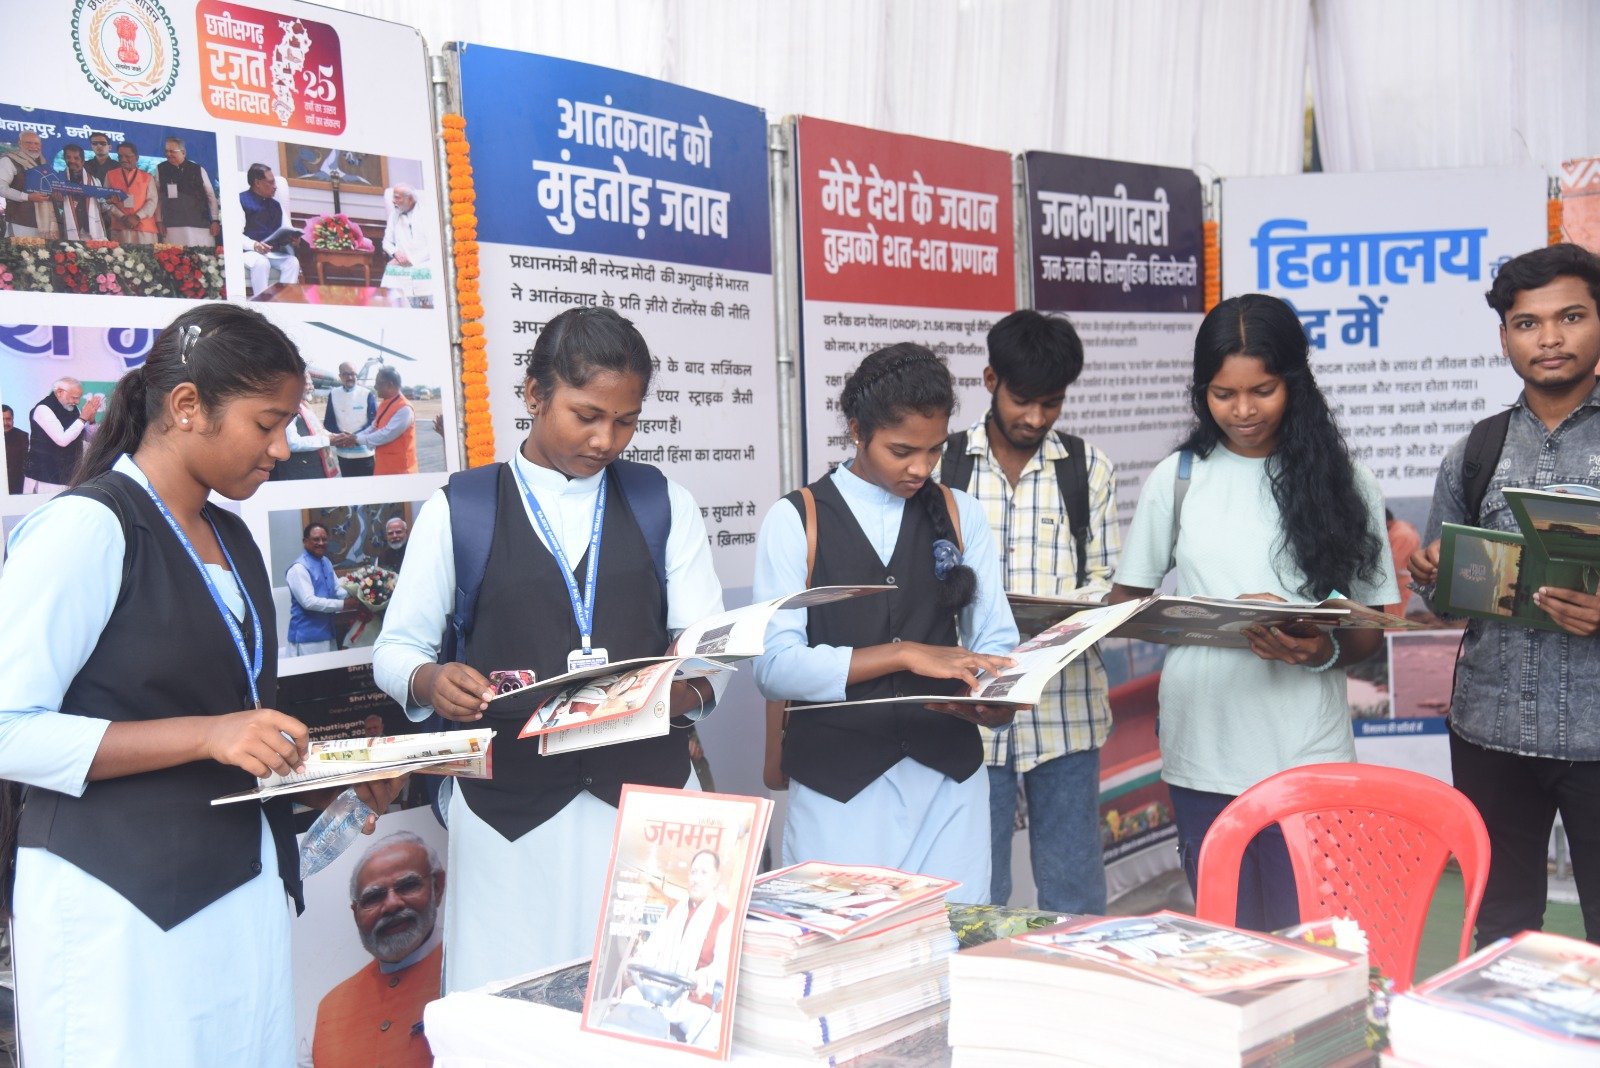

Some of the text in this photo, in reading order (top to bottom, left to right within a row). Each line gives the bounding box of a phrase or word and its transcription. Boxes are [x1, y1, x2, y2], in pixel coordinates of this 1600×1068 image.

[204, 11, 265, 50] छत्तीसगढ़
[205, 41, 267, 88] रजत
[302, 64, 337, 102] 25
[208, 82, 271, 116] महोत्सव
[64, 124, 126, 144] छत्तीगढ़
[557, 94, 713, 169] आतंकवाद को
[532, 148, 731, 240] मुंहतोड़ जवाब
[818, 157, 999, 234] मेरे देश के जवान
[1037, 183, 1170, 247] जनभागीदारी
[821, 222, 999, 276] तुझको शत-शत प्रणाम
[1250, 218, 1489, 291] हिमालय
[510, 253, 749, 292] प्रधानमंत्री श्री नरेन्द्र मोदी की अगुवाई में भारत
[1040, 250, 1198, 293] जन-जन की सामूहिक हिस्सेदारी
[510, 283, 751, 321] ने आतंकवाद के प्रति ज़ीरो टॉलरेंस की नीति
[1337, 295, 1389, 348] में
[825, 338, 838, 352] को
[667, 356, 679, 373] के
[684, 361, 706, 376] बाद
[710, 358, 753, 377] सर्जिकल
[656, 387, 754, 407] एयर स्ट्राइक जैसी
[666, 444, 692, 463] हिंसा
[694, 449, 710, 462] का
[713, 448, 742, 462] दायरा
[742, 445, 755, 461] भी
[712, 501, 744, 523] सुधारों
[746, 500, 756, 516] से
[349, 695, 366, 703] Shri
[643, 818, 728, 853] जनमन
